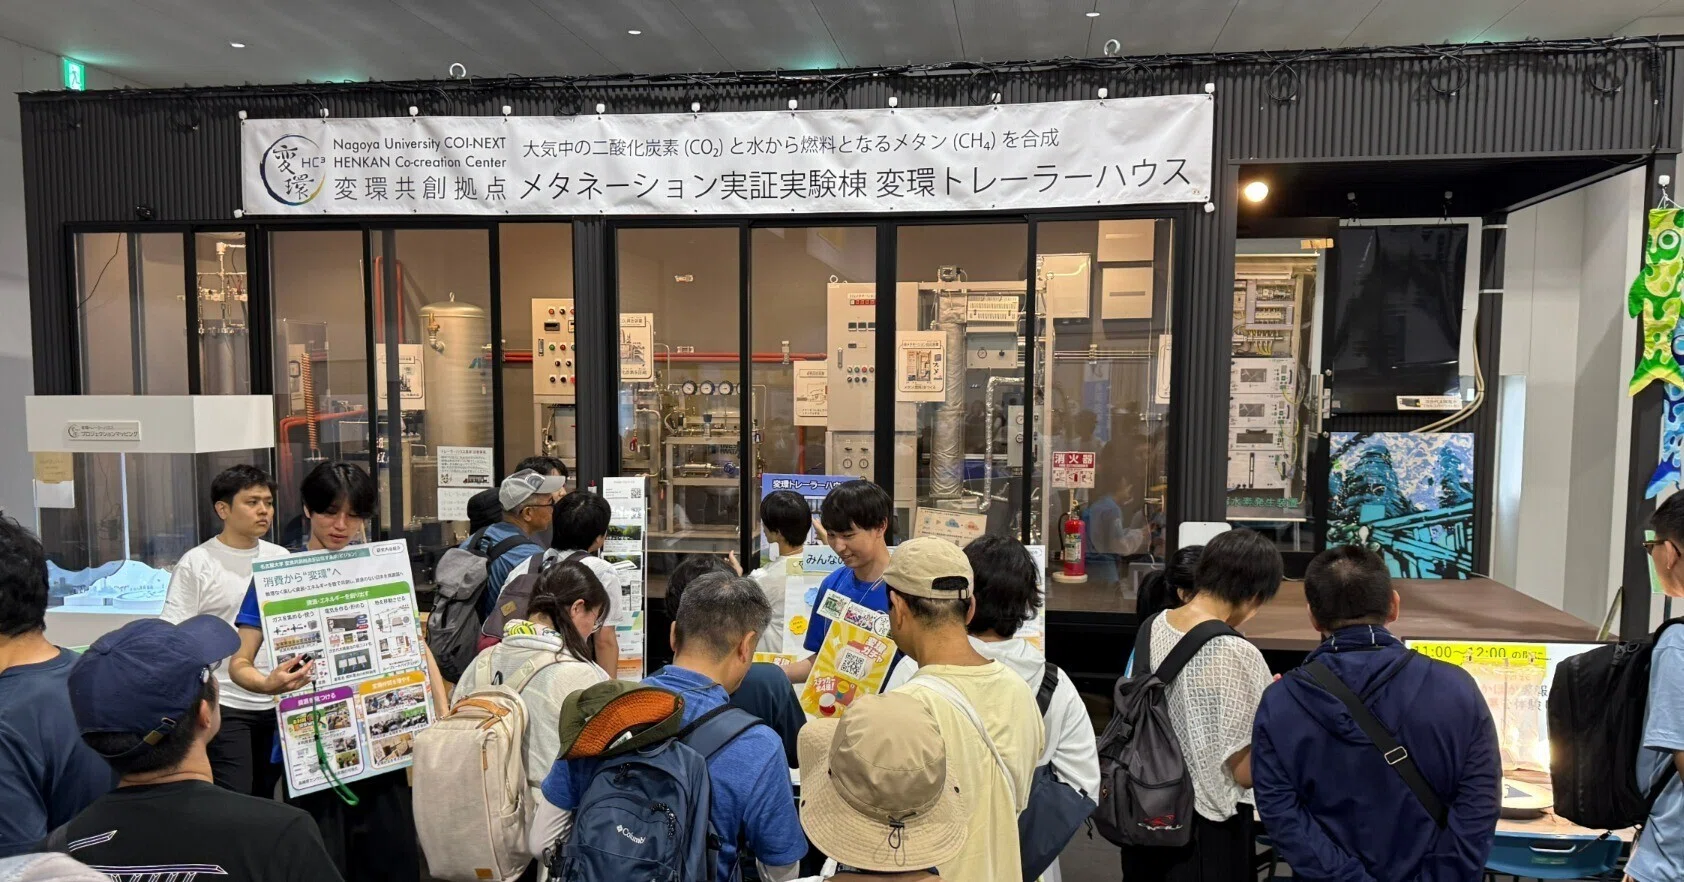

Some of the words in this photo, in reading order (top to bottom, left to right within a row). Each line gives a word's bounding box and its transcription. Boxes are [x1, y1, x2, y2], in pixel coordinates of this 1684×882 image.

[333, 139, 380, 153] Nagoya
[384, 138, 441, 152] University
[444, 136, 506, 149] COI-NEXT
[523, 138, 679, 158] 大気中の二酸化炭素
[730, 133, 947, 156] と水から燃料となるメタン
[1003, 128, 1060, 149] を合成
[334, 156, 390, 168] HENKAN
[395, 155, 461, 167] Co-creation
[465, 155, 507, 168] Center
[334, 175, 506, 201] 変環共創拠点
[520, 169, 867, 201] メタネーション実証実験棟
[876, 158, 1191, 199] 変環トレーラーハウス
[1054, 453, 1093, 464] 消火器
[1227, 496, 1298, 508] 水素発生装置
